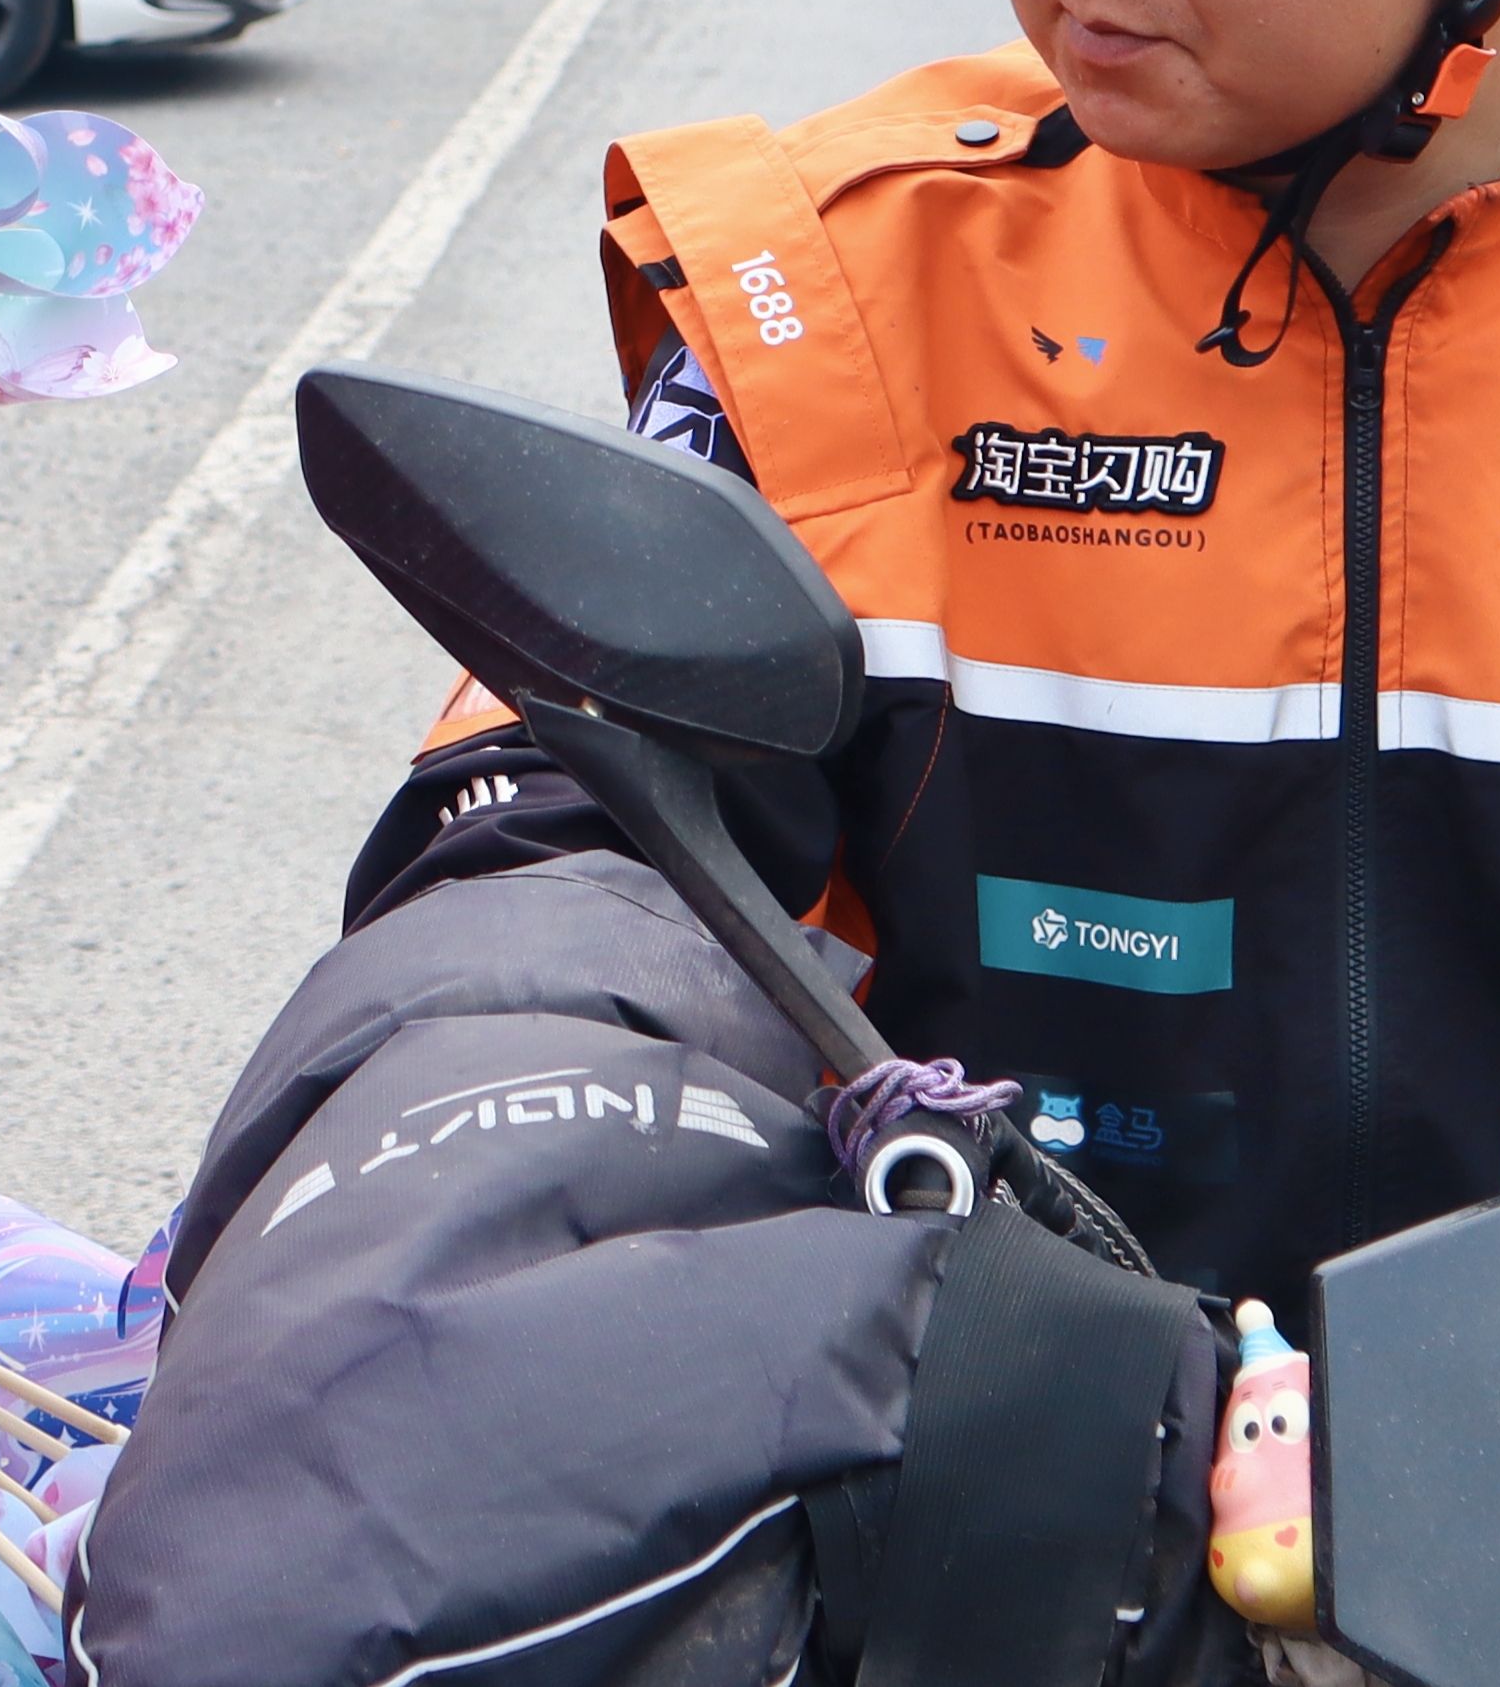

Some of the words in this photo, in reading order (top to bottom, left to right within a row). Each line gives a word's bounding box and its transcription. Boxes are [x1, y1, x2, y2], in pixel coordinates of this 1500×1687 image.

[731, 250, 804, 346] 1688
[966, 431, 1213, 505] 淘宝闪购
[965, 521, 1206, 552] (TAOBAOSHANGOU)
[1075, 921, 1179, 960] TONGYI
[1094, 1103, 1164, 1150] 盒马
